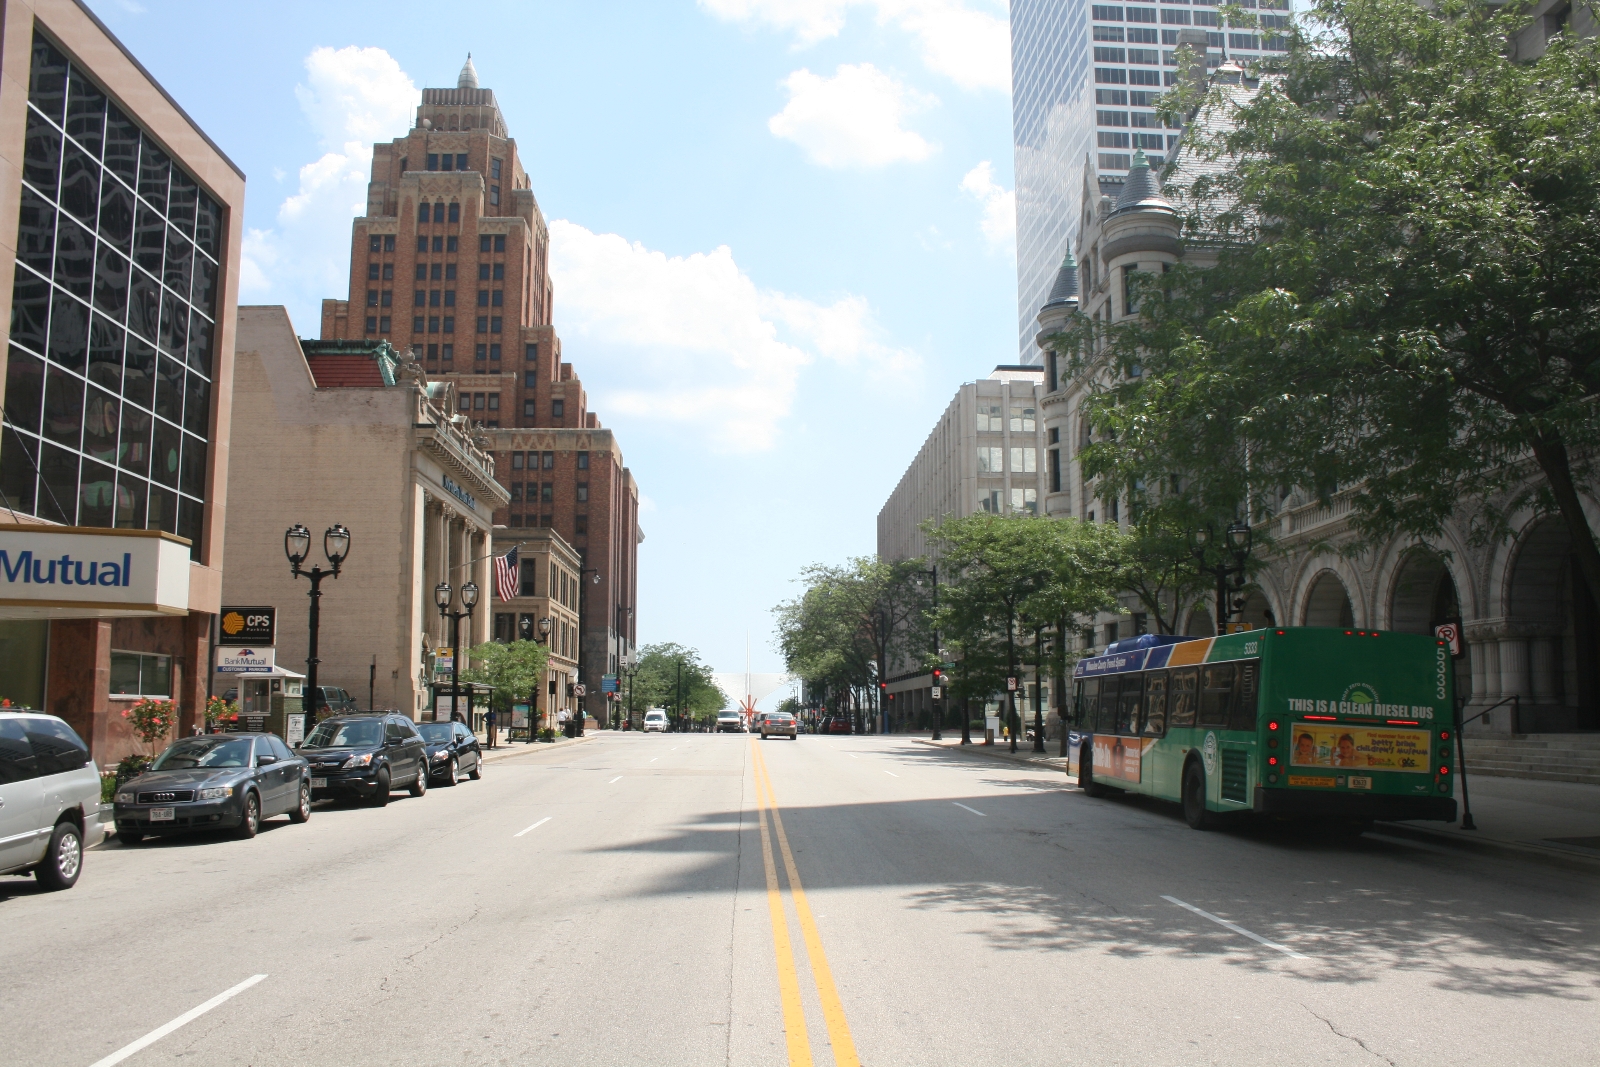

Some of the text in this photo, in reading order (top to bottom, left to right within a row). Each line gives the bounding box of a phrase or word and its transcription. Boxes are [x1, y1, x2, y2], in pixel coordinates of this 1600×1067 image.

[0, 549, 131, 587] Mutual
[246, 615, 270, 627] CPS
[1436, 648, 1446, 700] 5333
[1288, 698, 1434, 720] THIS IS A CLEAN DIESEL BUS
